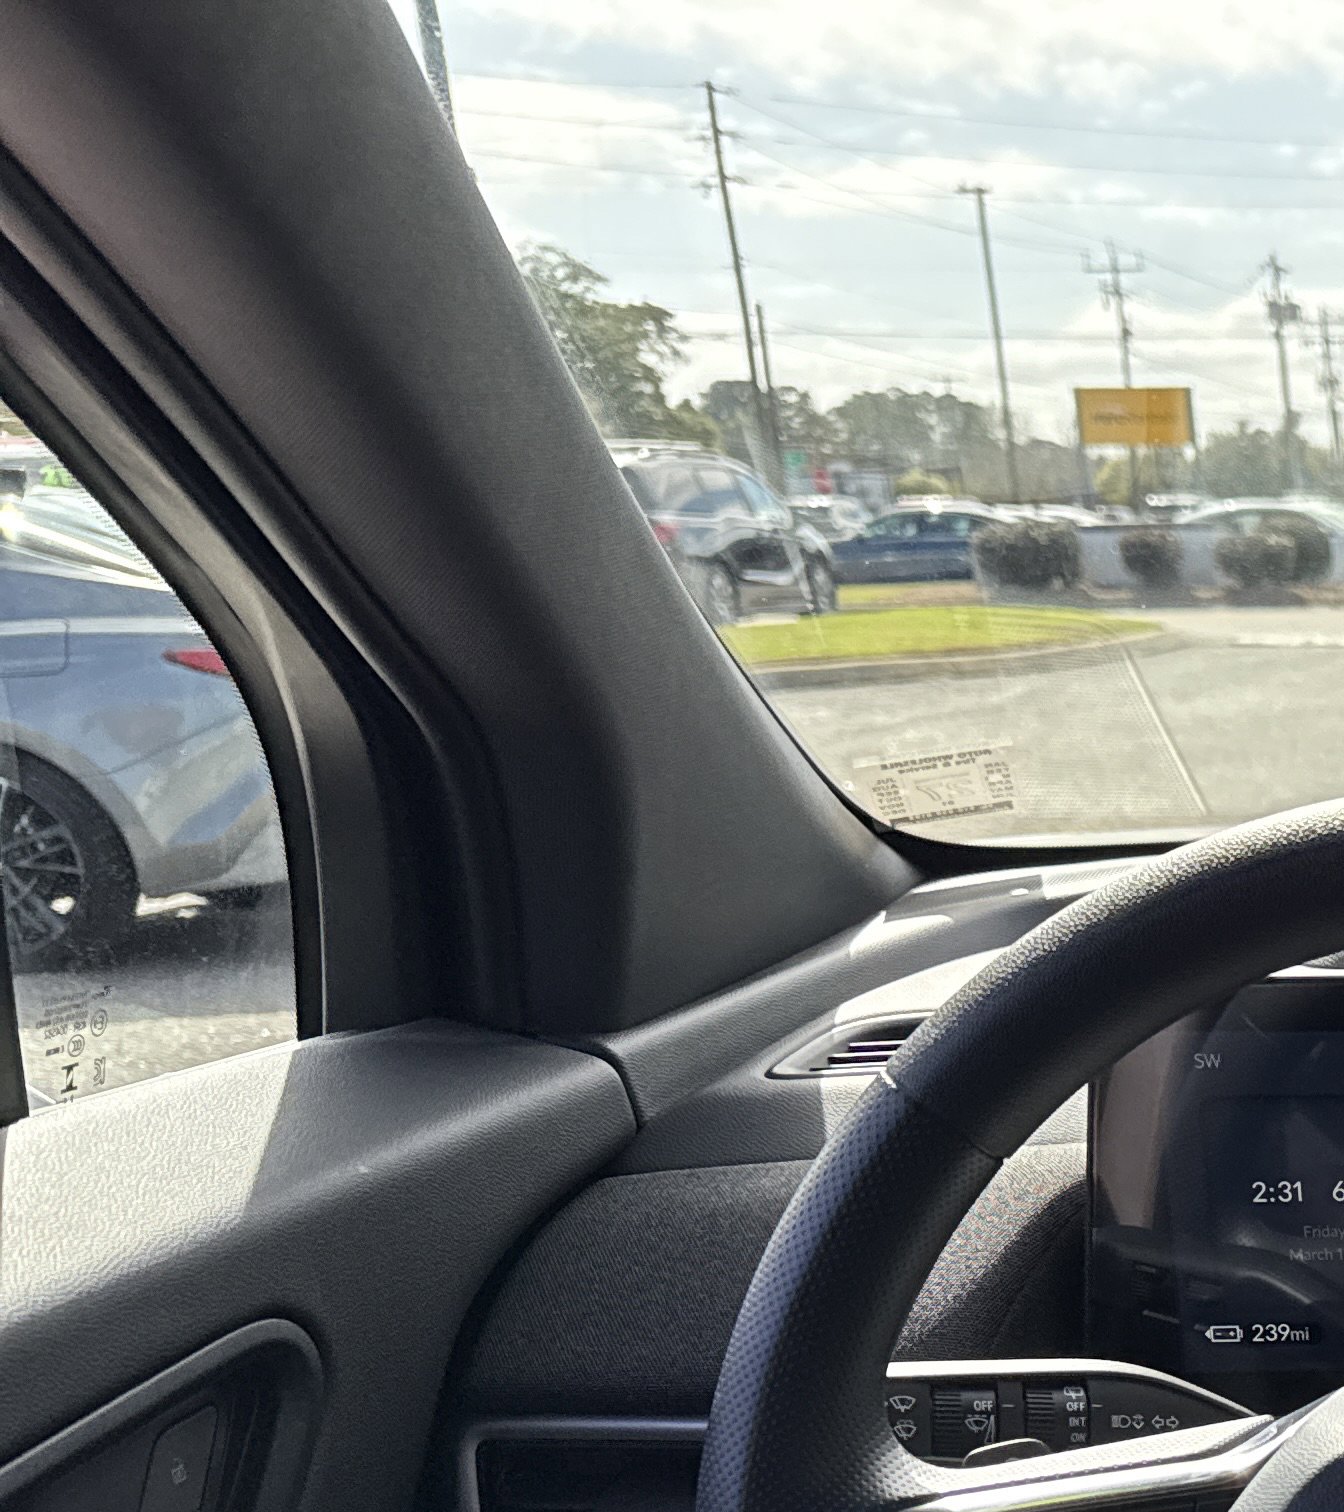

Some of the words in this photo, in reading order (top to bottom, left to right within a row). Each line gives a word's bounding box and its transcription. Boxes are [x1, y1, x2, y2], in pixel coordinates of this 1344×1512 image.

[1193, 1053, 1222, 1069] SW
[1252, 1181, 1303, 1203] 2:31
[1289, 1248, 1334, 1261] March
[1252, 1323, 1310, 1342] 239mi
[973, 1400, 993, 1411] OFF
[1066, 1402, 1086, 1411] OFF
[1069, 1417, 1087, 1427] INT
